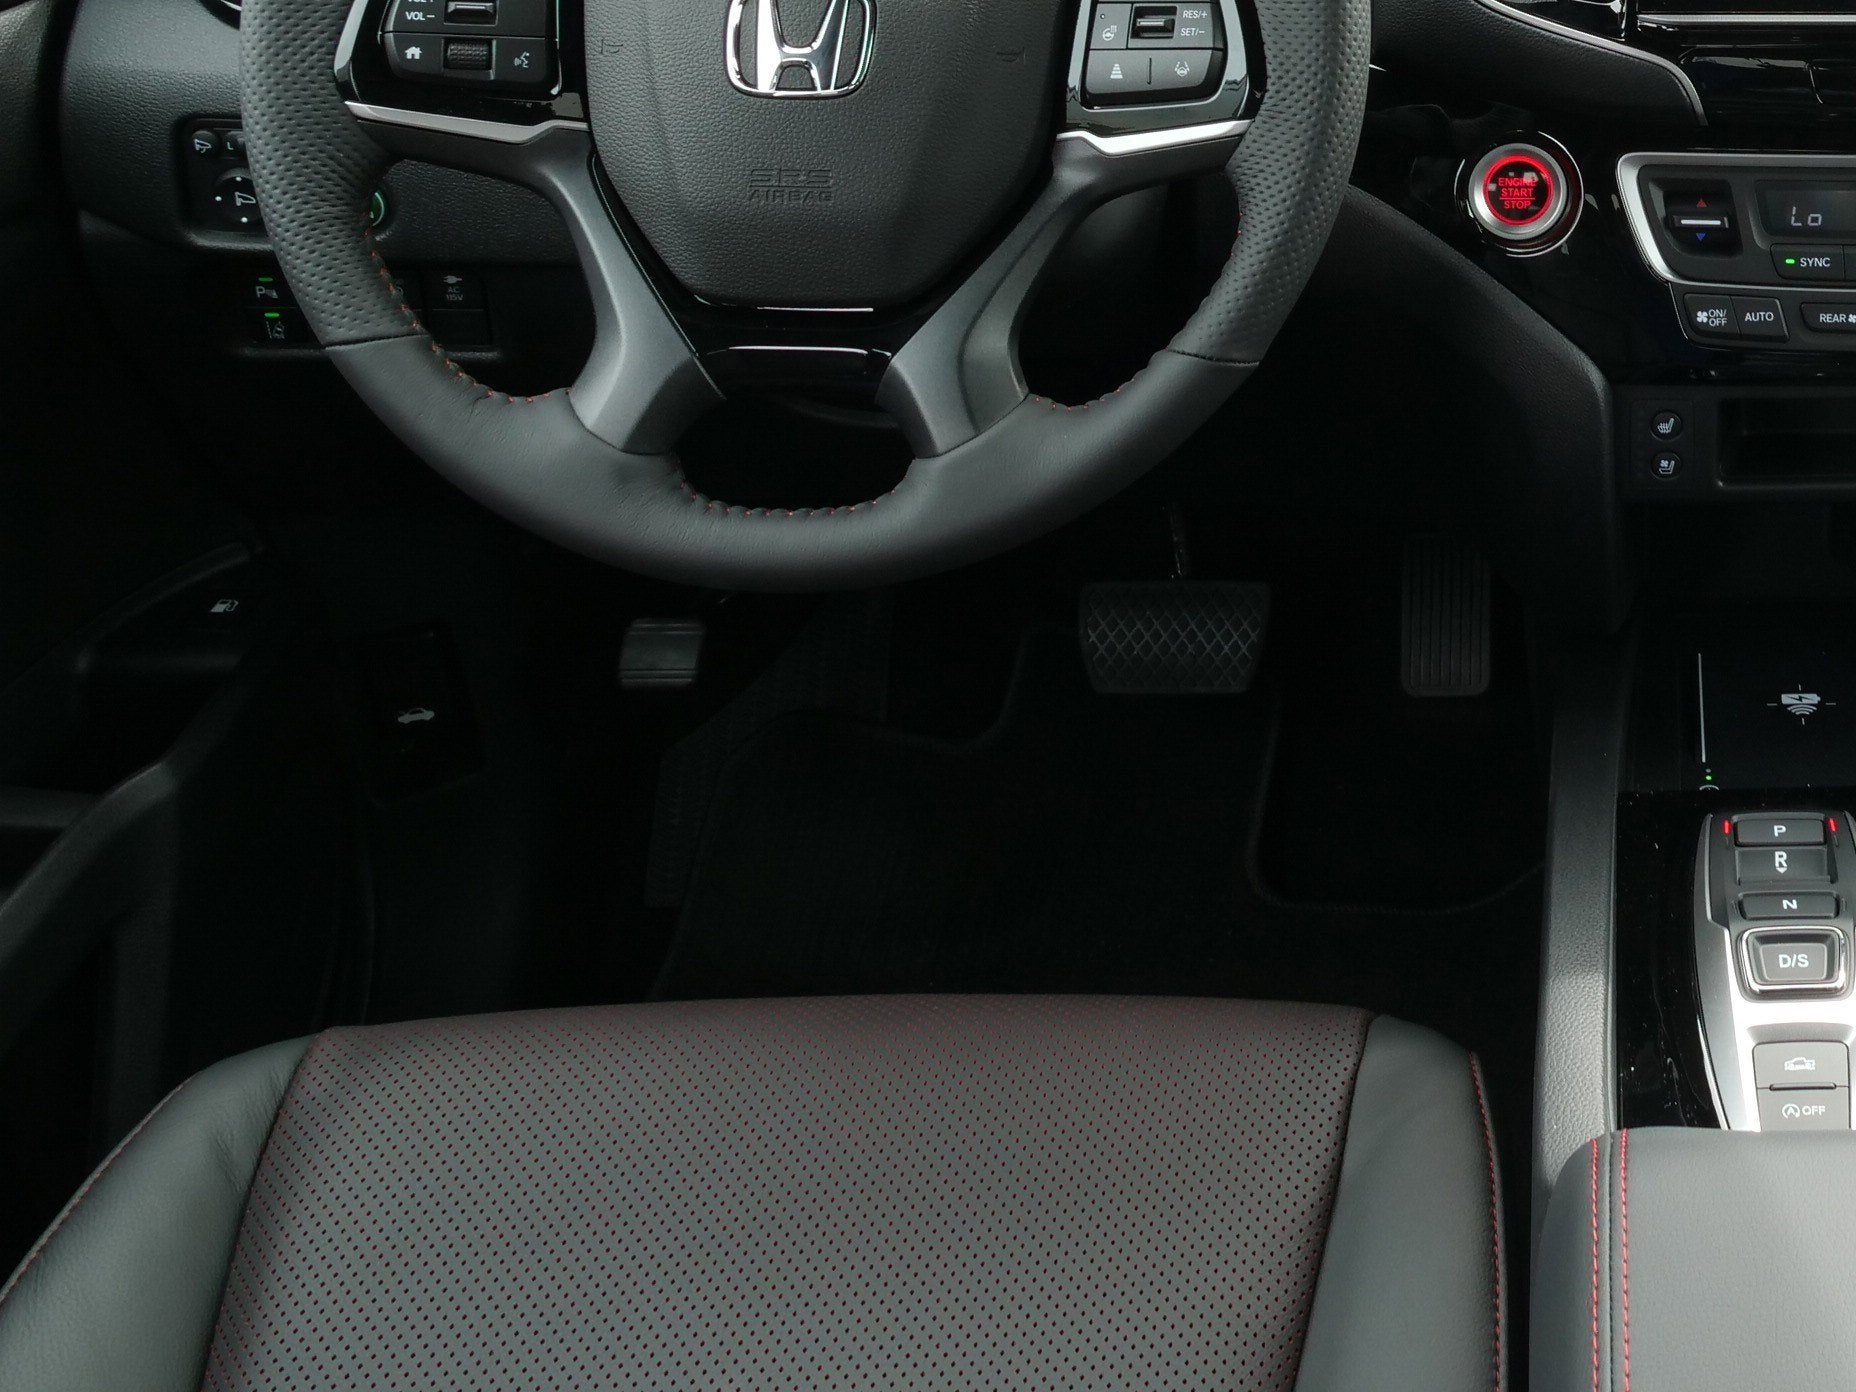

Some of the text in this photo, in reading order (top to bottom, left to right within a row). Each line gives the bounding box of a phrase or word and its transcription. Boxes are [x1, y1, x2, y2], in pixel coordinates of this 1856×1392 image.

[1182, 10, 1208, 19] RES/+
[1498, 178, 1536, 186] ENGINE
[1501, 188, 1533, 197] START
[1800, 258, 1831, 267] SYNC
[1709, 309, 1727, 318] ON/
[1745, 312, 1774, 322] AUTO
[1709, 318, 1727, 326] OFF
[1820, 314, 1846, 323] REAR
[1774, 825, 1787, 837] P
[1775, 851, 1788, 868] R
[1782, 899, 1797, 909] N
[1778, 953, 1810, 969] D/S
[1802, 1104, 1826, 1115] OFF
